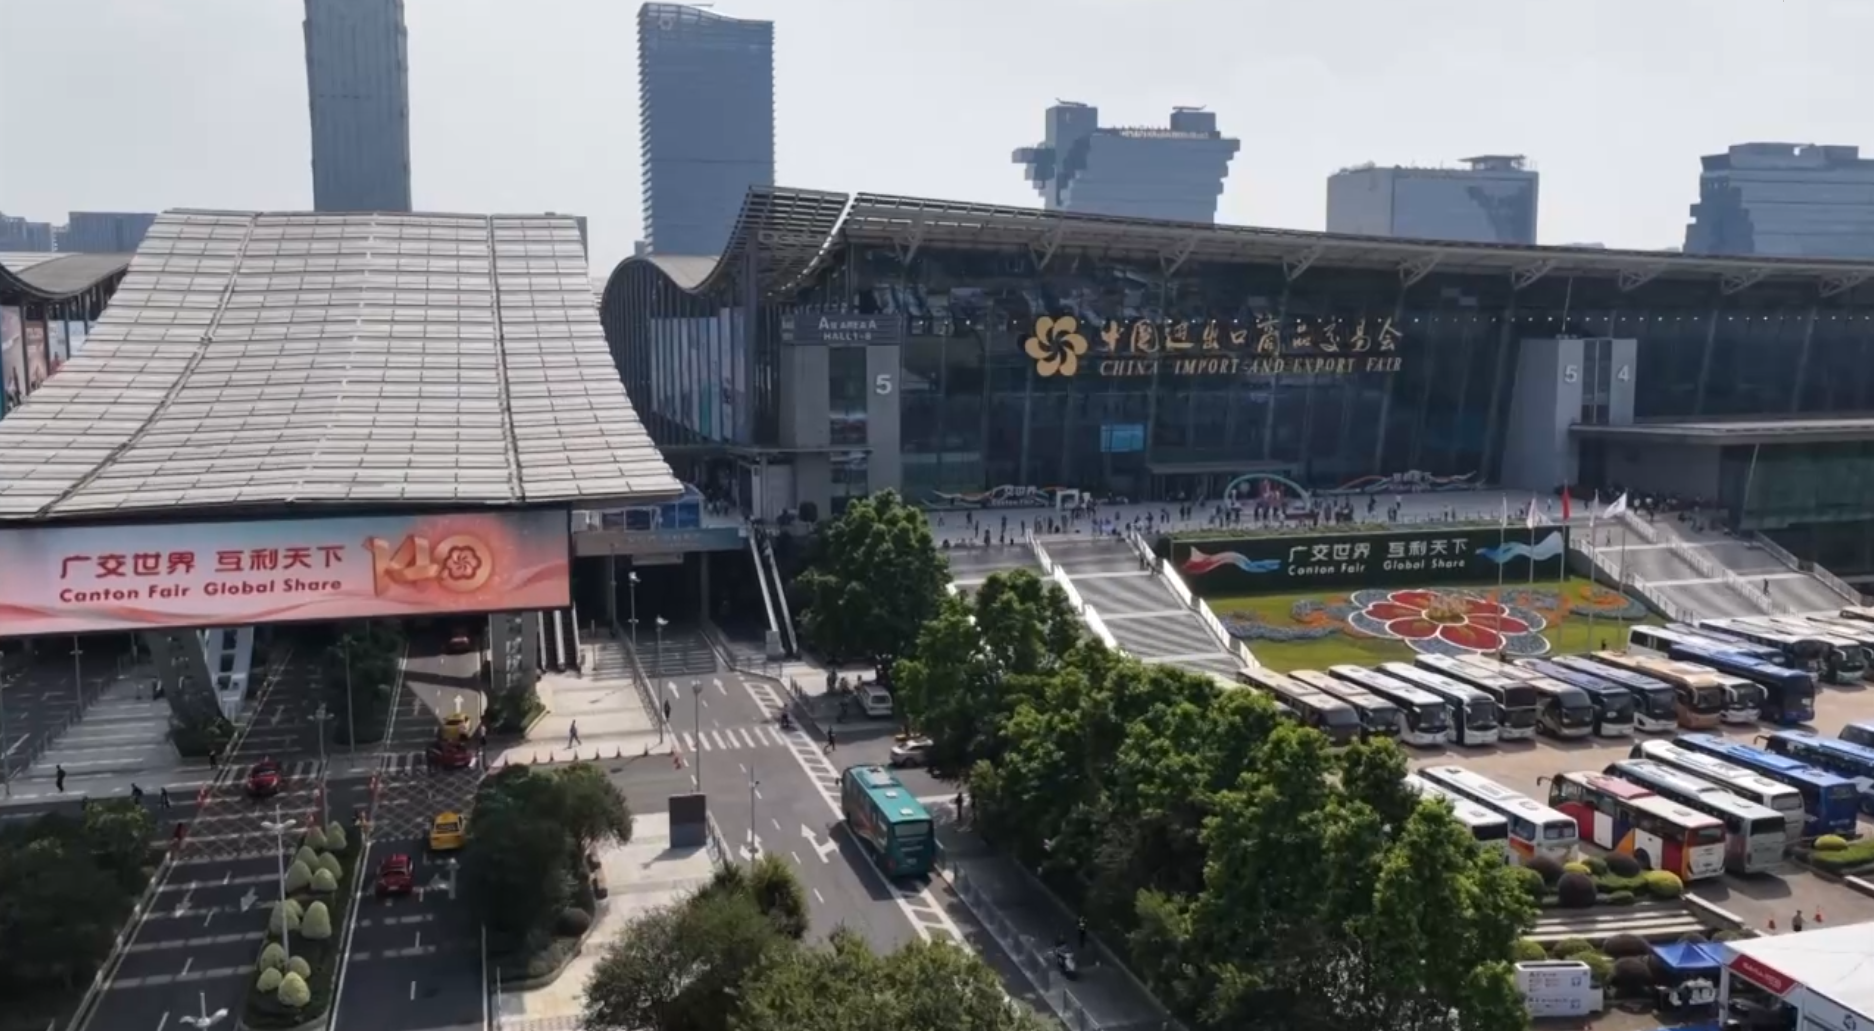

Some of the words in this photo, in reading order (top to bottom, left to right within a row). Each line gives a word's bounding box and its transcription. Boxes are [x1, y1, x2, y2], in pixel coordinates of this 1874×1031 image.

[868, 320, 877, 330] A
[1101, 314, 1403, 356] 中国进出口商品交易会
[1100, 360, 1158, 376] CHINA
[1174, 358, 1240, 375] IMPORT
[1250, 357, 1285, 374] AND
[1292, 356, 1357, 374] EXPORT
[1365, 357, 1403, 373] FAIR
[1564, 365, 1578, 382] 5
[1617, 365, 1630, 382] 4
[876, 374, 893, 395] 5
[1288, 542, 1371, 563] 广交世界
[1387, 538, 1469, 559] 互利天下
[60, 551, 196, 579] 广交世界
[215, 545, 345, 573] 互利天下
[1288, 563, 1335, 576] Canton
[1340, 562, 1366, 574] Fair
[1383, 559, 1425, 571] Global
[1432, 557, 1465, 569] Share
[60, 587, 139, 603] Canton
[149, 584, 191, 599] Fair
[204, 580, 275, 597] Global
[283, 577, 342, 593] Share
